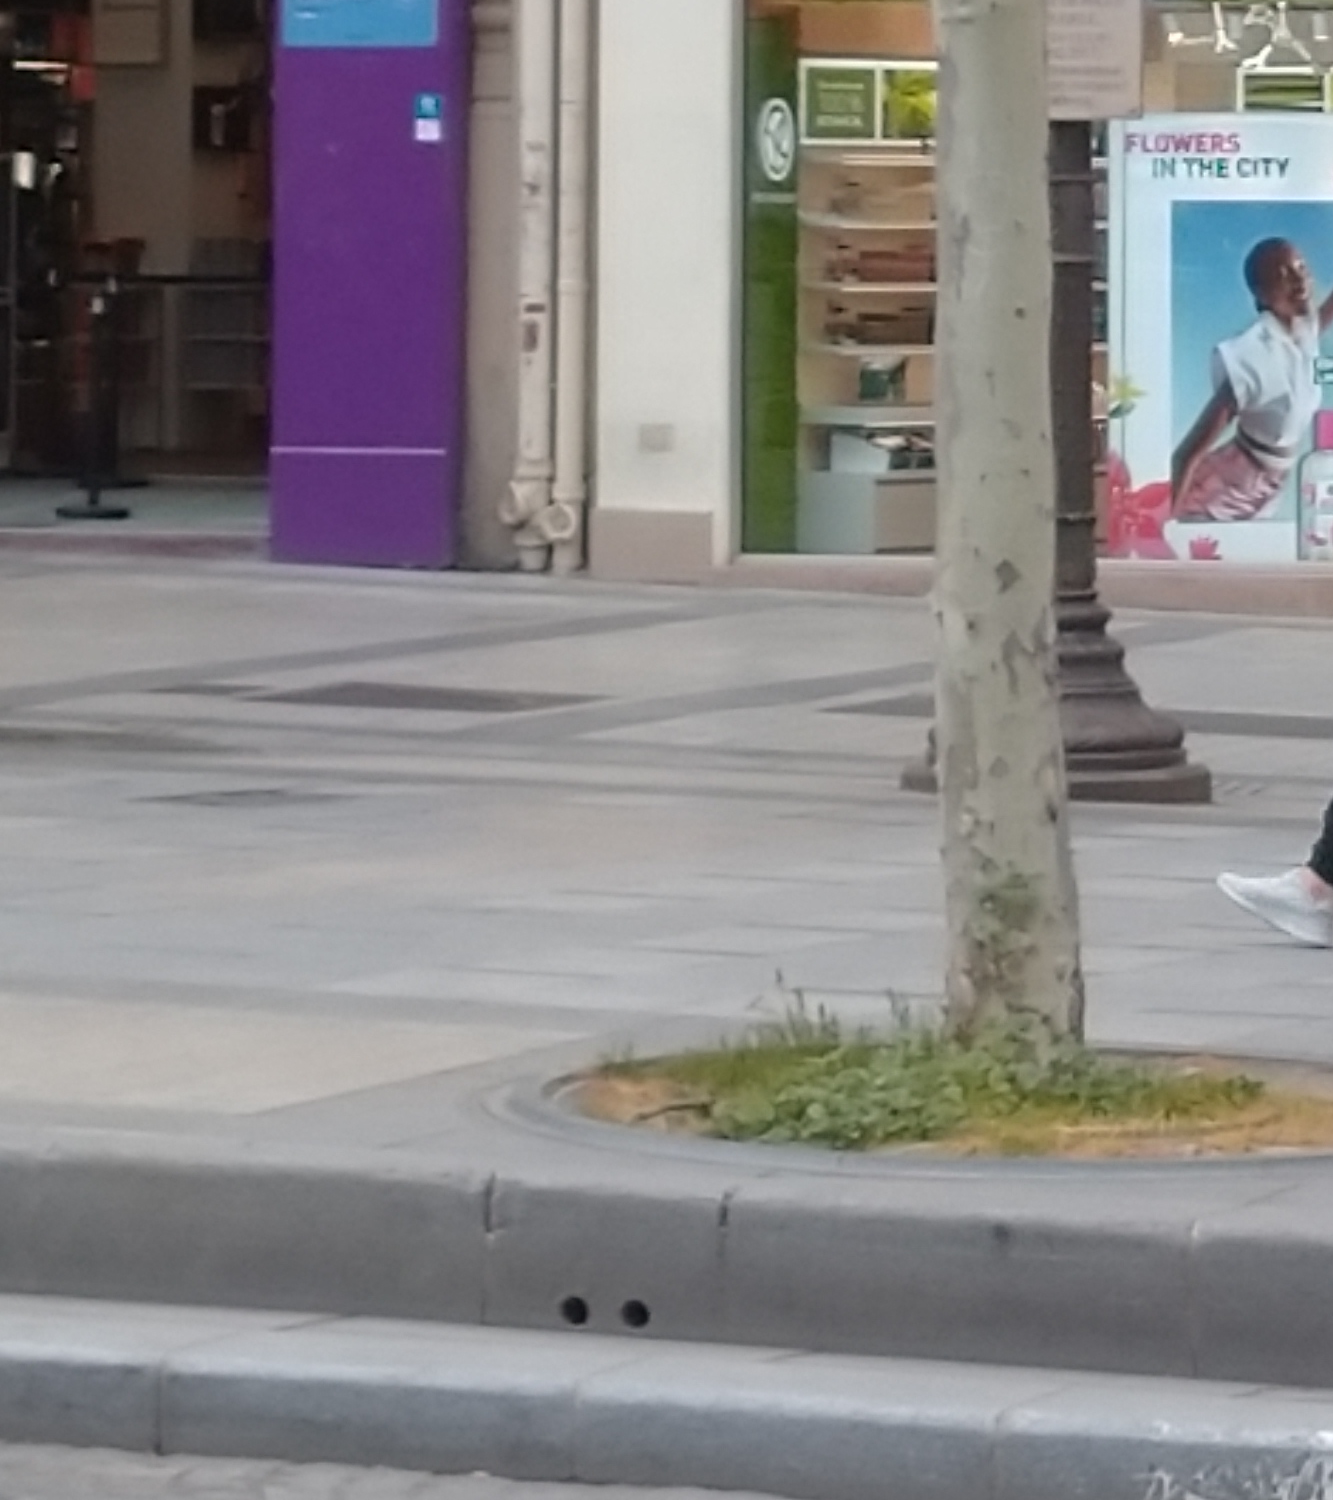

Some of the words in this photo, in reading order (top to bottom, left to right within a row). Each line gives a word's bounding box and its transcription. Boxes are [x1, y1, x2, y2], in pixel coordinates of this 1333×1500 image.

[1124, 132, 1241, 154] FLOWERS
[1151, 156, 1176, 179] IN
[1182, 156, 1229, 179] THE
[1236, 156, 1290, 179] CITY
